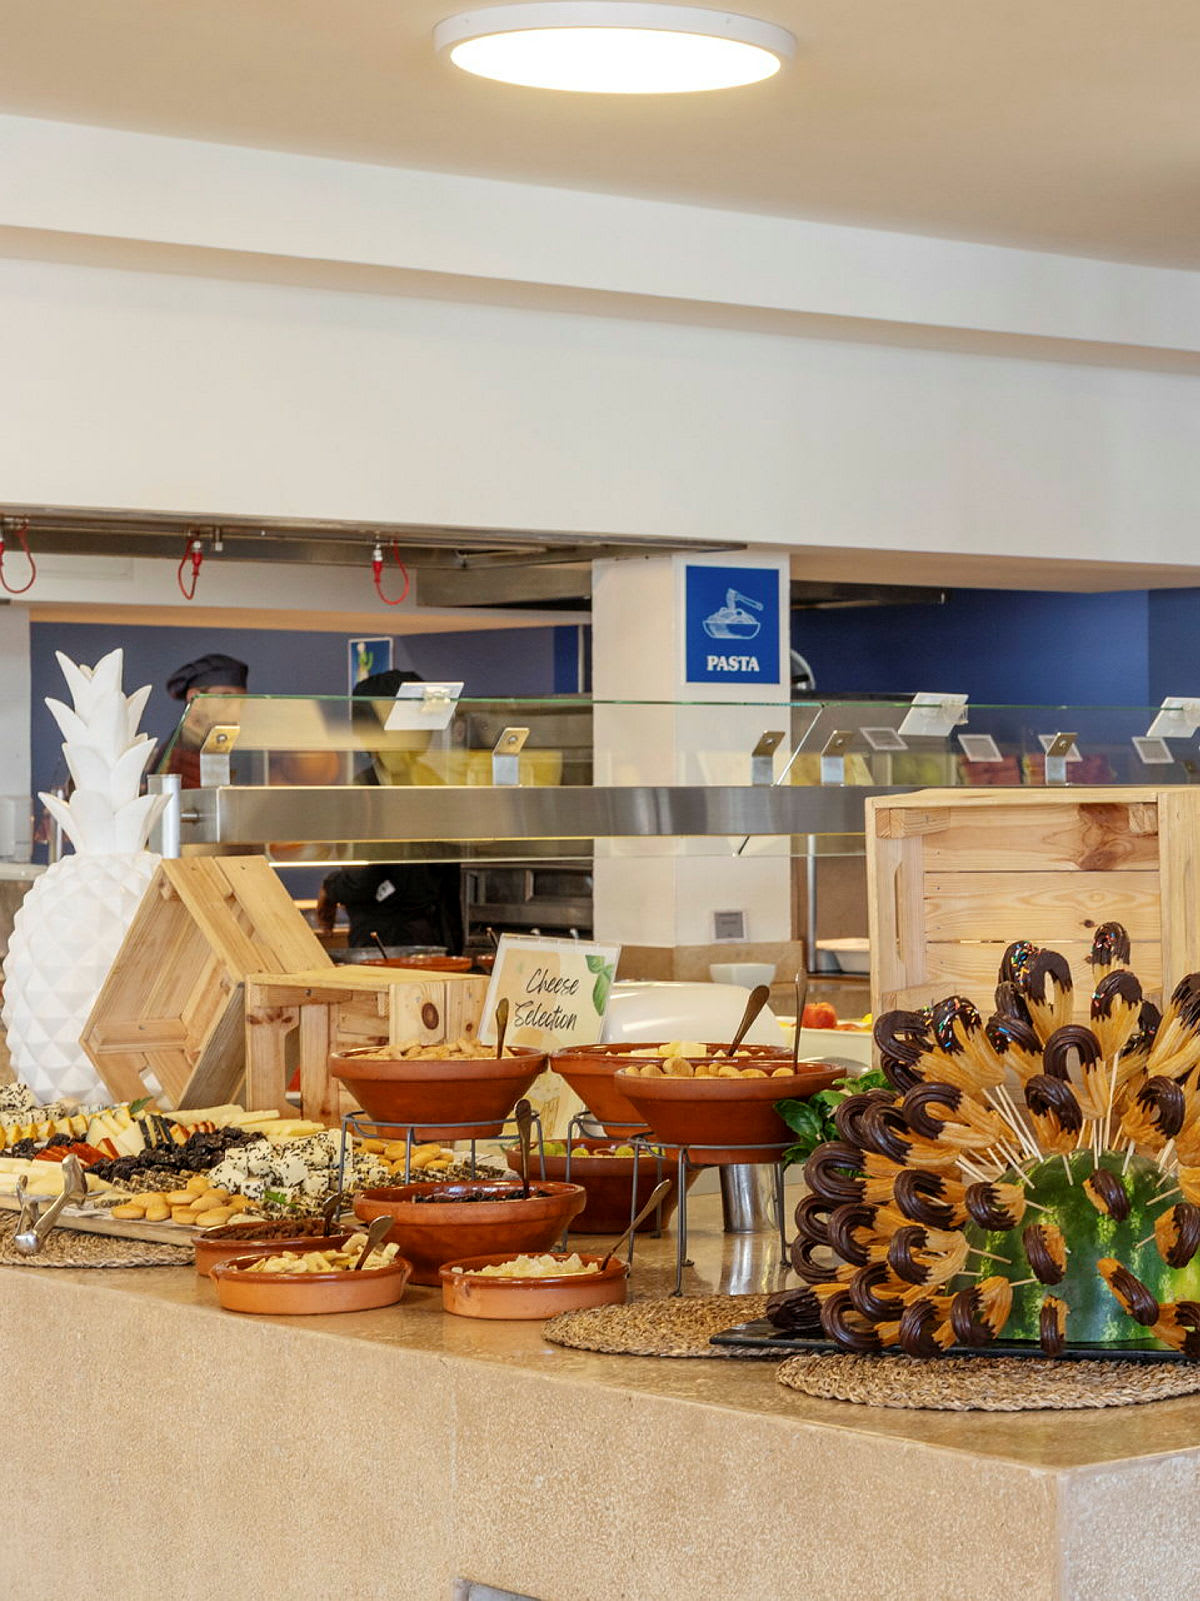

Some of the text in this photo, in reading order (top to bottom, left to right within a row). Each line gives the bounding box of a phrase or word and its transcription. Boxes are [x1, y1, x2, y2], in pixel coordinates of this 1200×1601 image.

[706, 655, 760, 672] PASTA
[526, 968, 580, 996] Cheese
[514, 1000, 578, 1031] Selection
